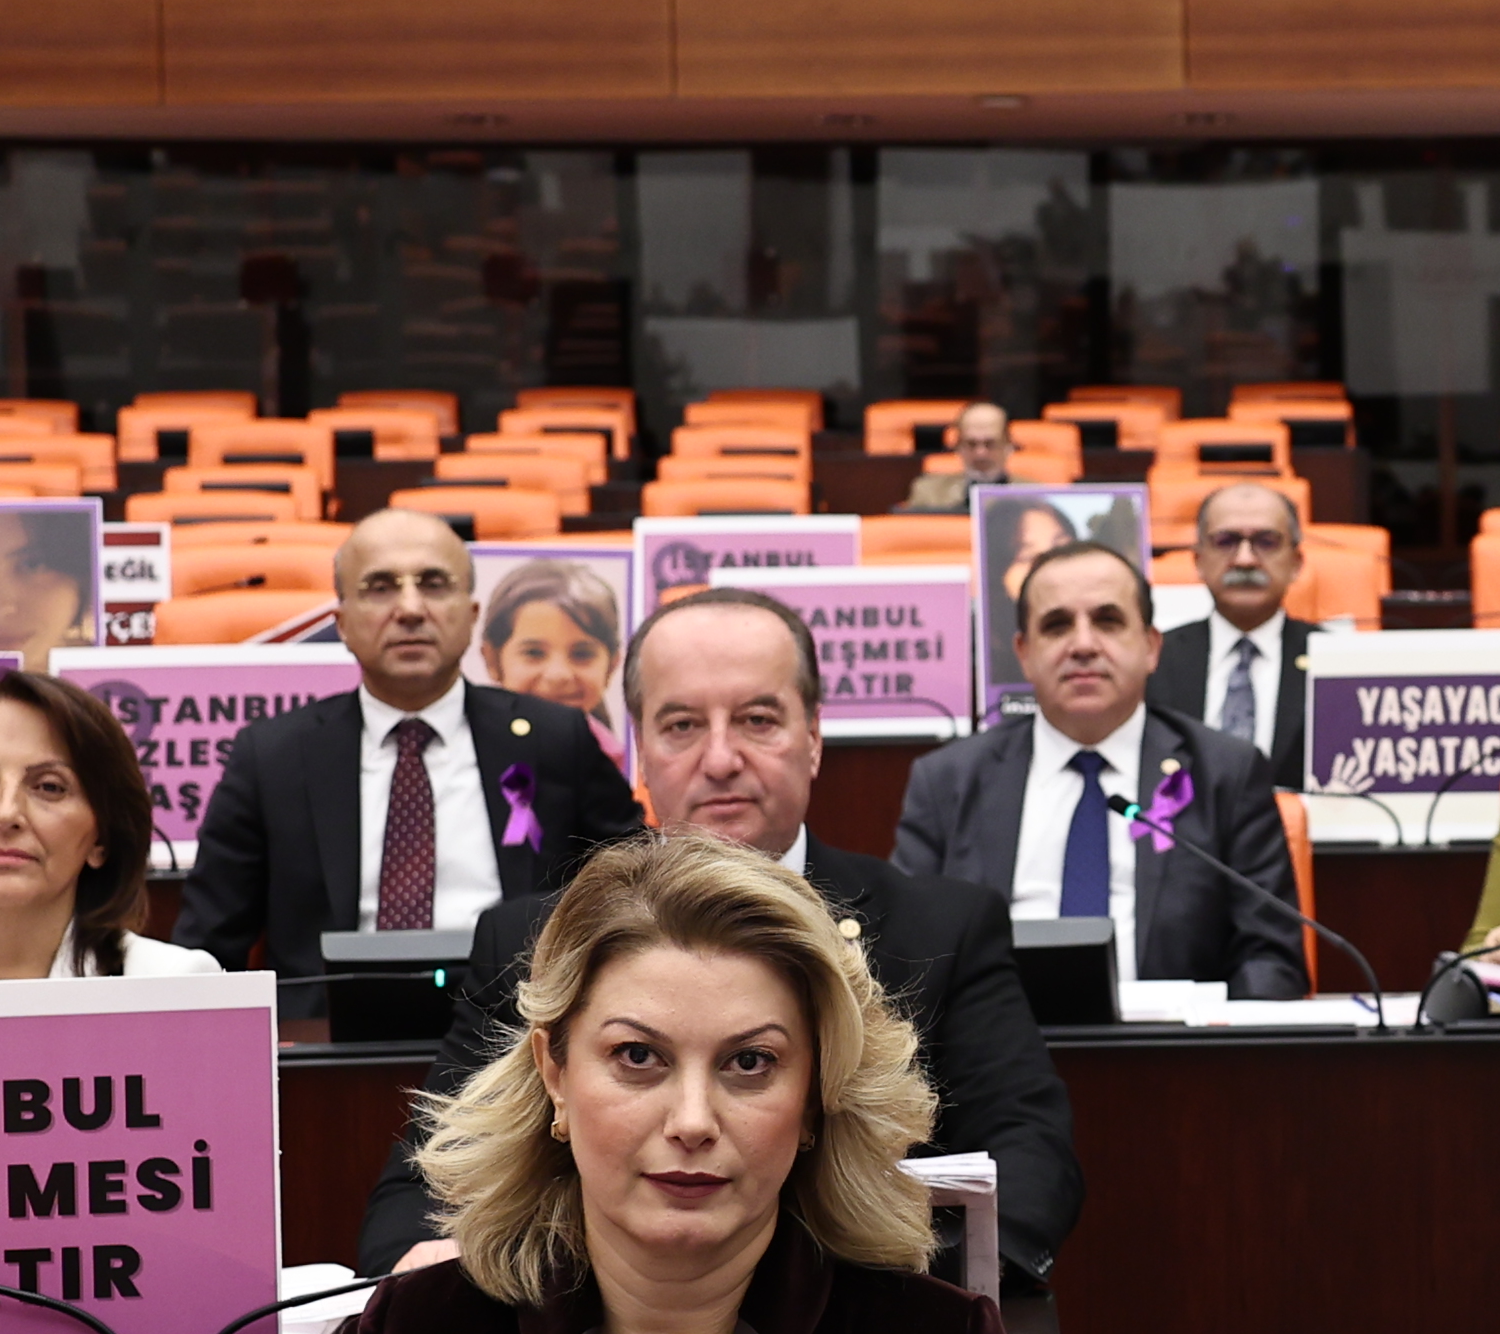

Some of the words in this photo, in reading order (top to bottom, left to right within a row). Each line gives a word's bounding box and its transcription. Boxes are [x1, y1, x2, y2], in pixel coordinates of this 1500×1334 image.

[794, 605, 923, 629] ANBUL
[821, 629, 943, 671] EŞMESİ
[103, 690, 317, 724] İSTANBU
